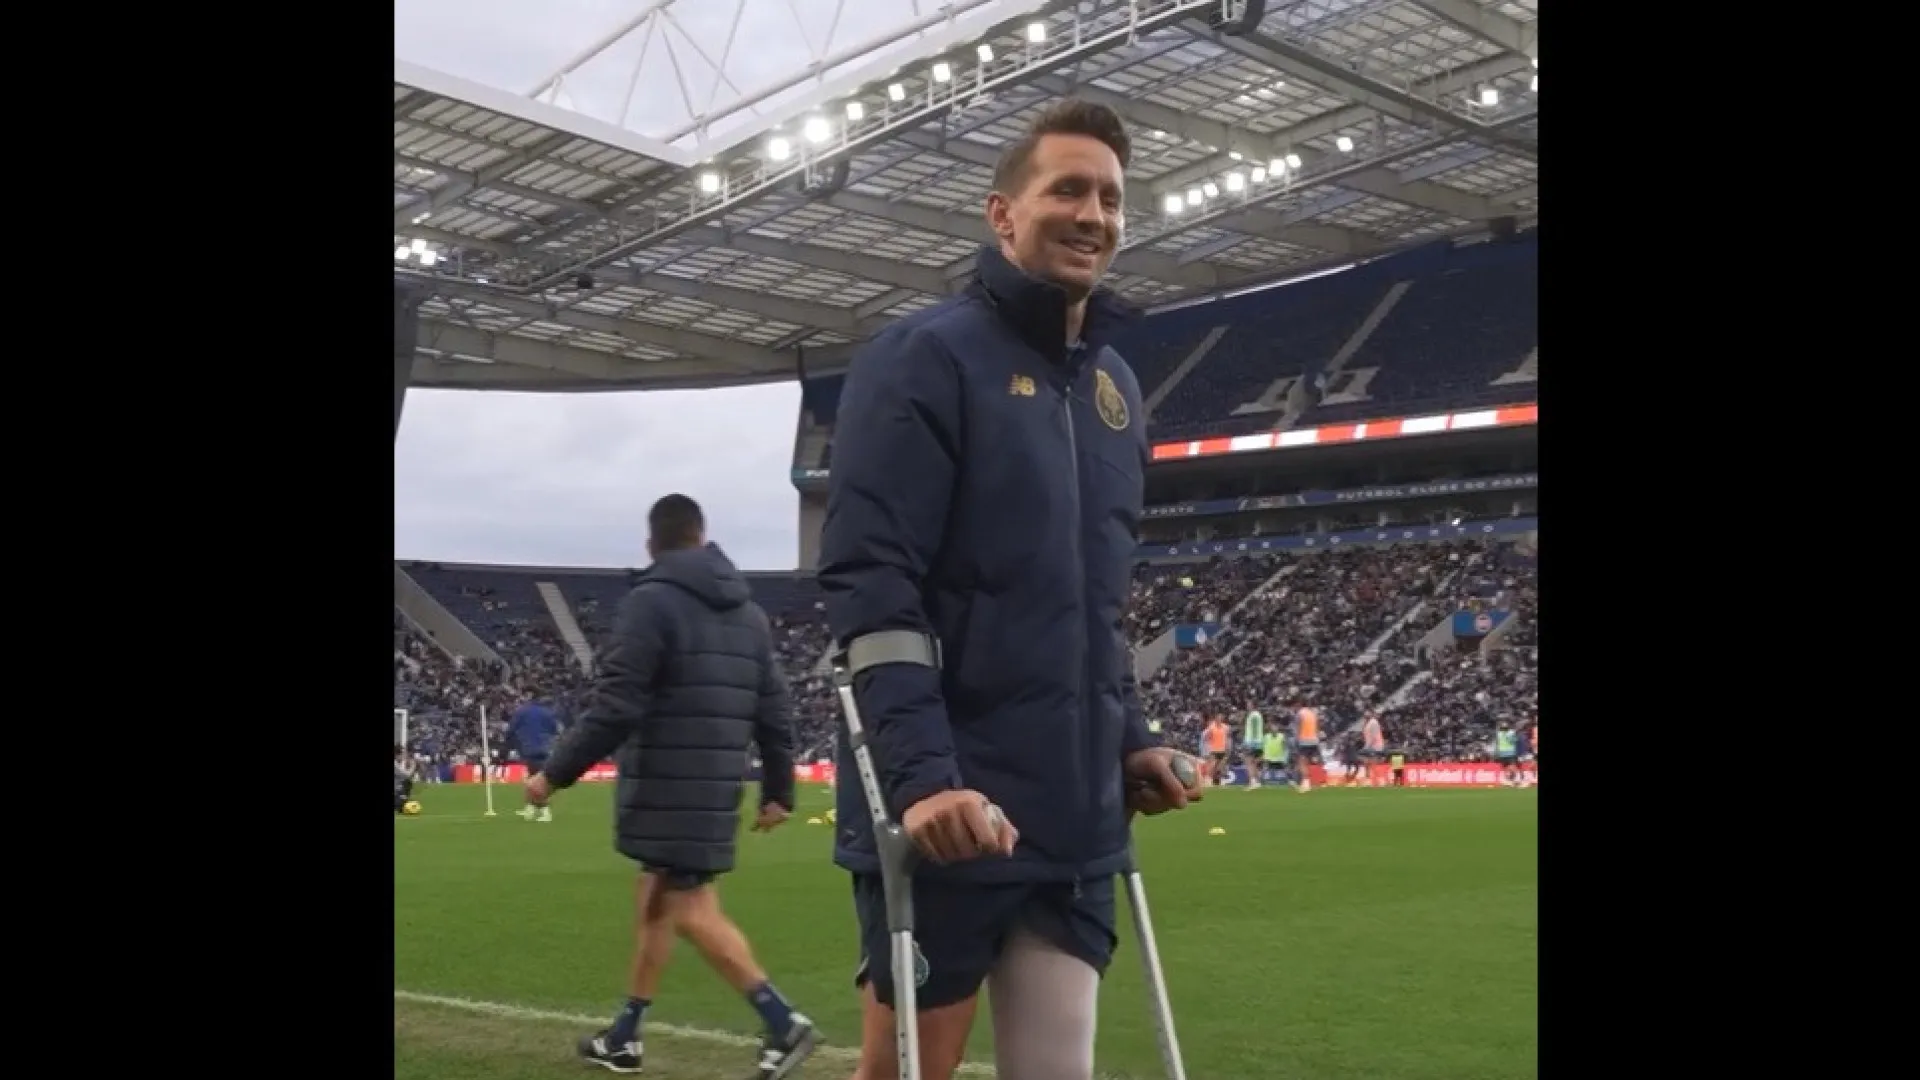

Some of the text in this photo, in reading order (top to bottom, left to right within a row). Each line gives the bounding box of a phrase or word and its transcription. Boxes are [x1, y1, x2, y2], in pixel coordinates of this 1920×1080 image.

[1008, 374, 1036, 397] NB
[1336, 491, 1404, 500] FUTEBOL
[1492, 475, 1537, 487] PORT
